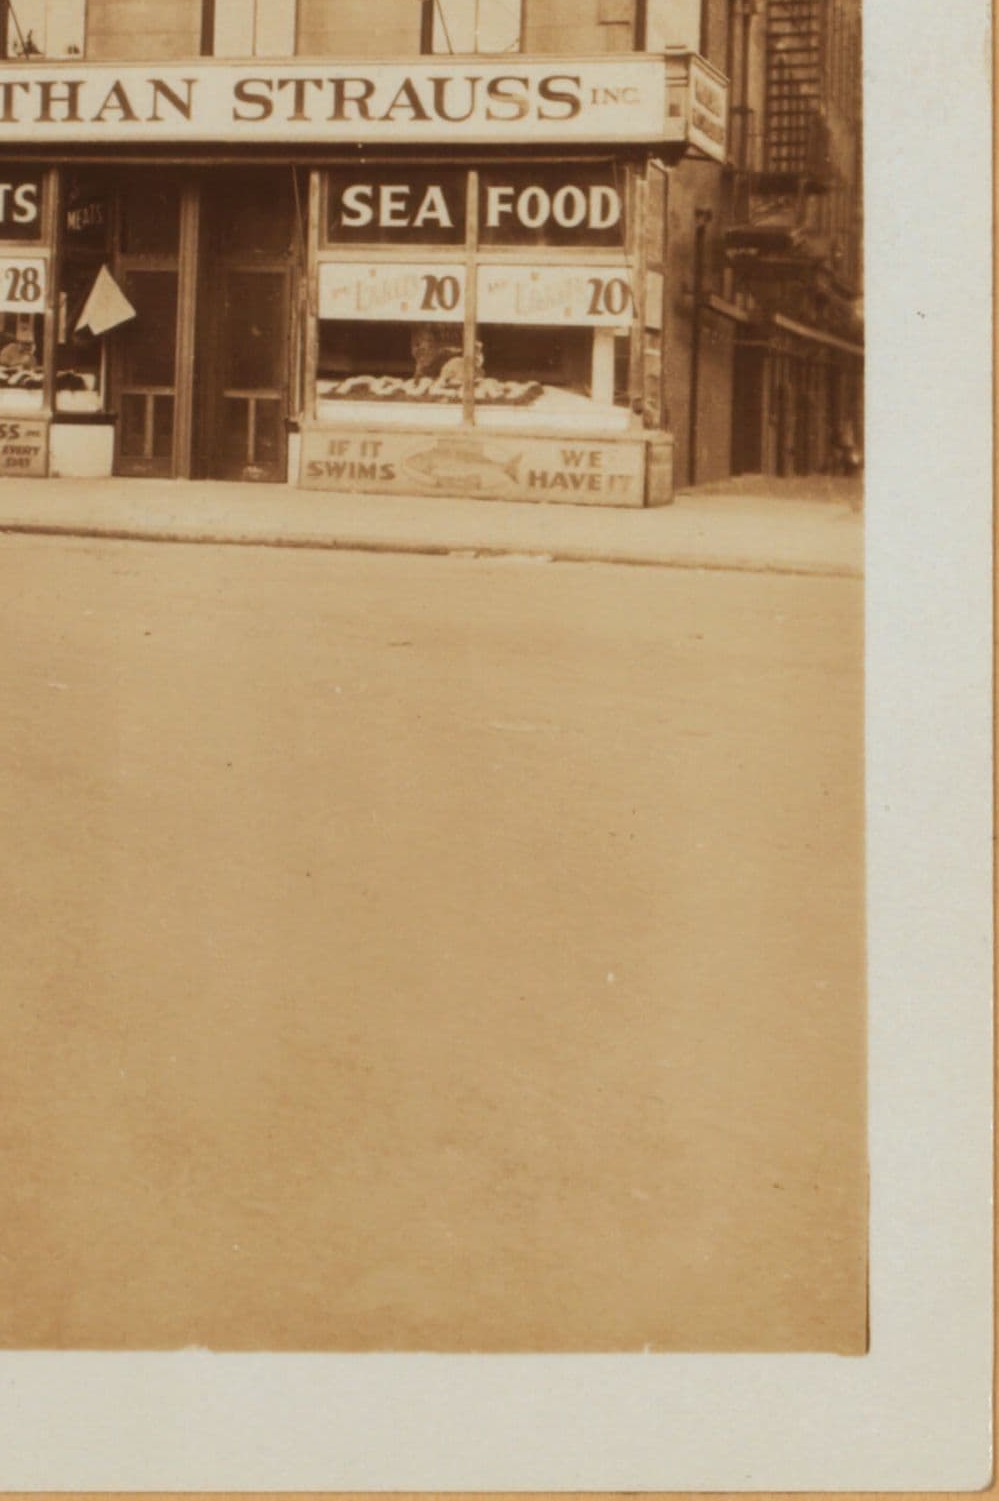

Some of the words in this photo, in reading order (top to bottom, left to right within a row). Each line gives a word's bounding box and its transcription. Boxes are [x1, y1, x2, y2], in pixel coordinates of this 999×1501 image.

[232, 74, 583, 124] STRAUSS
[341, 185, 454, 229] SEA
[485, 186, 622, 230] FOOD
[3, 266, 42, 302] 28
[328, 439, 349, 457] IF
[360, 440, 384, 458] IT
[560, 449, 603, 469] WE
[306, 460, 397, 481] SWIMS
[527, 469, 601, 492] HAVE
[606, 474, 635, 492] IT
